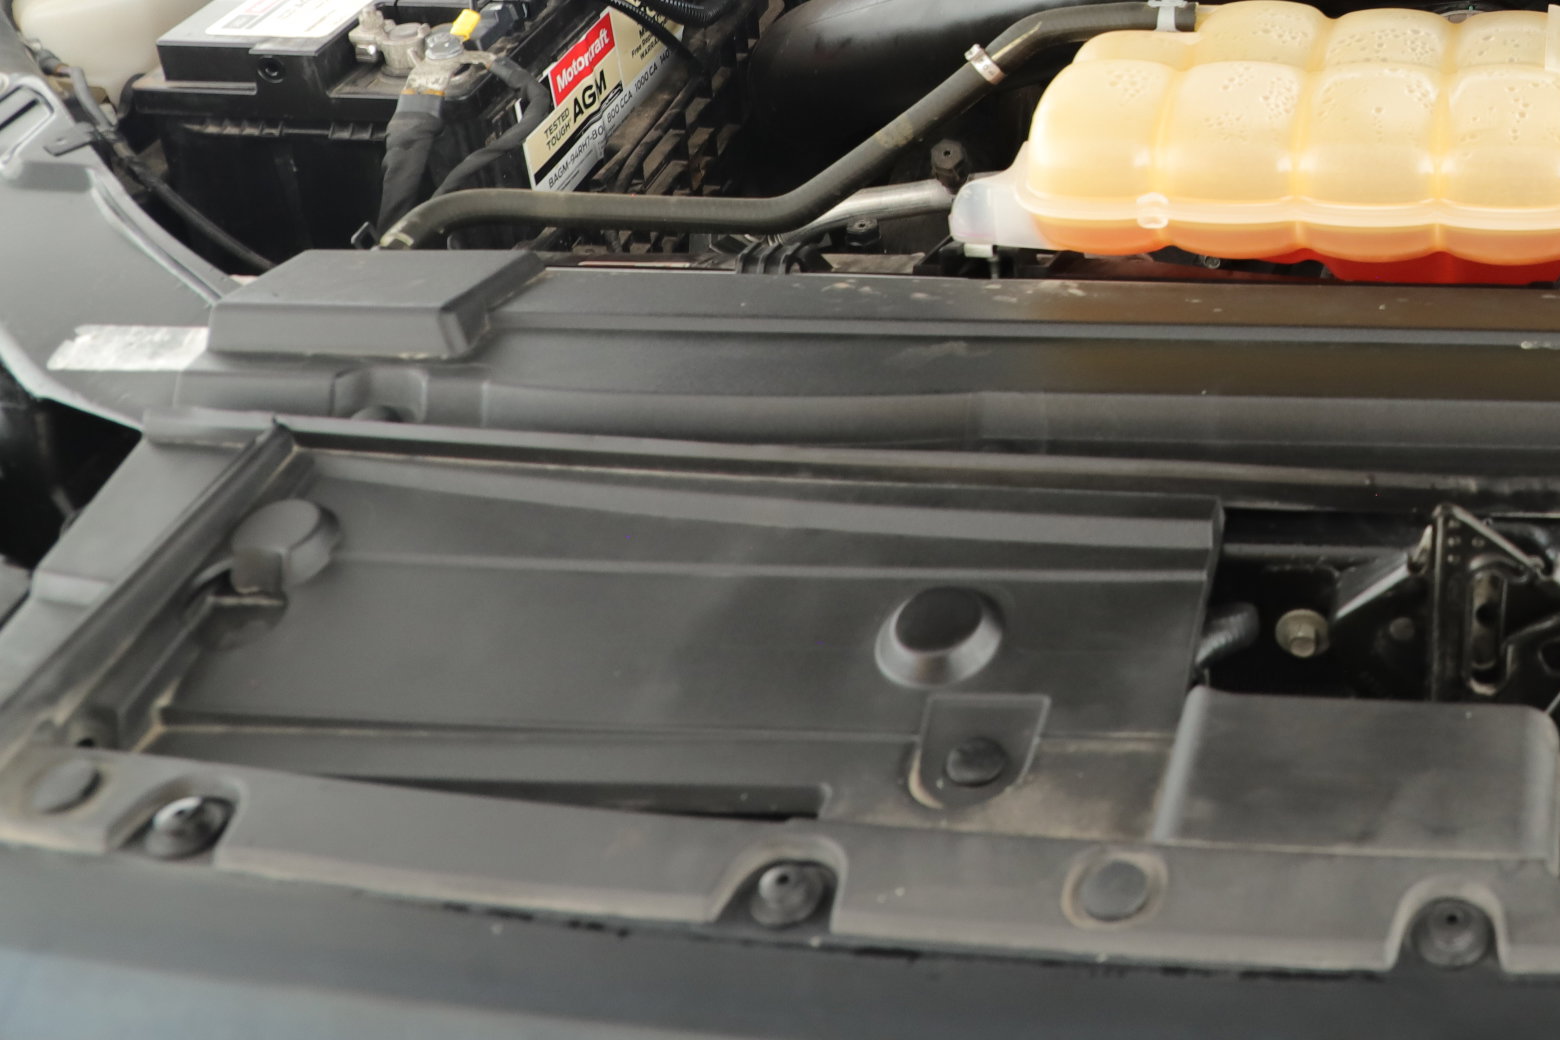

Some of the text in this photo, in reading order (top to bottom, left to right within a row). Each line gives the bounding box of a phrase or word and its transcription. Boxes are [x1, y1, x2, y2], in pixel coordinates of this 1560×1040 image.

[544, 69, 607, 138] TESTED AGM
[619, 91, 633, 109] CCA
[634, 72, 649, 92] 1000
[649, 63, 658, 77] CA
